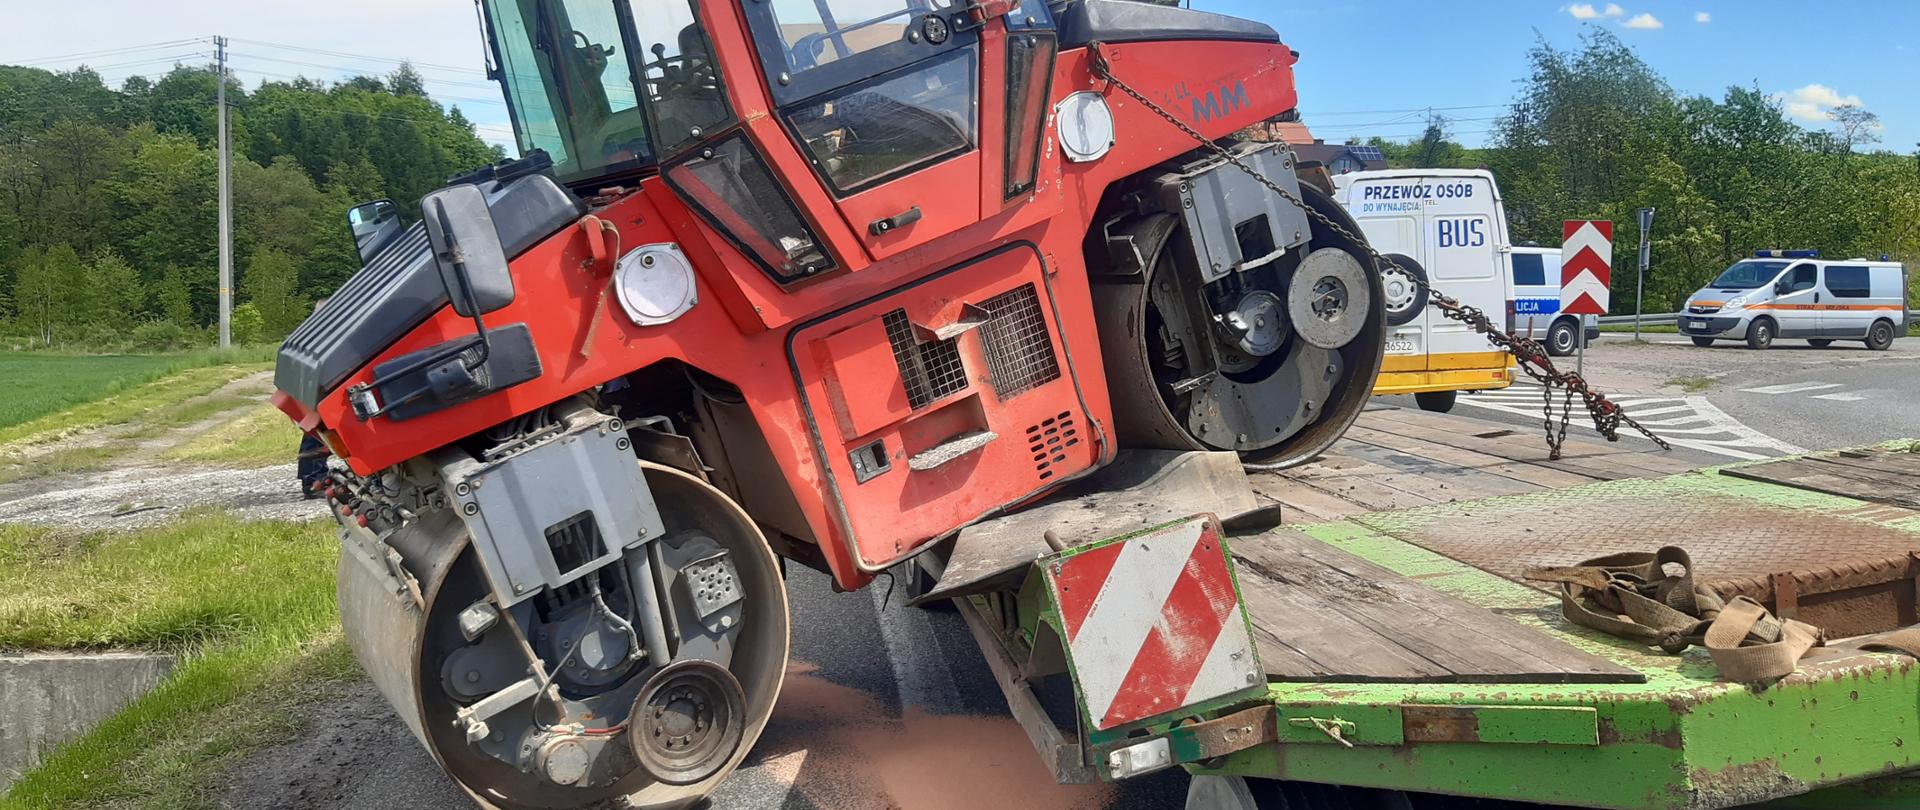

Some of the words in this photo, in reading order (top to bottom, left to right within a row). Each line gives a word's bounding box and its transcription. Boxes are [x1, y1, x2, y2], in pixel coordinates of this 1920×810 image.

[1364, 181, 1432, 200] PRZEWÓZ
[1436, 180, 1473, 198] OSÓB
[1363, 203, 1374, 212] DO
[1438, 219, 1484, 247] BUS
[1516, 302, 1539, 311] LICJA
[1385, 341, 1412, 351] 36522
